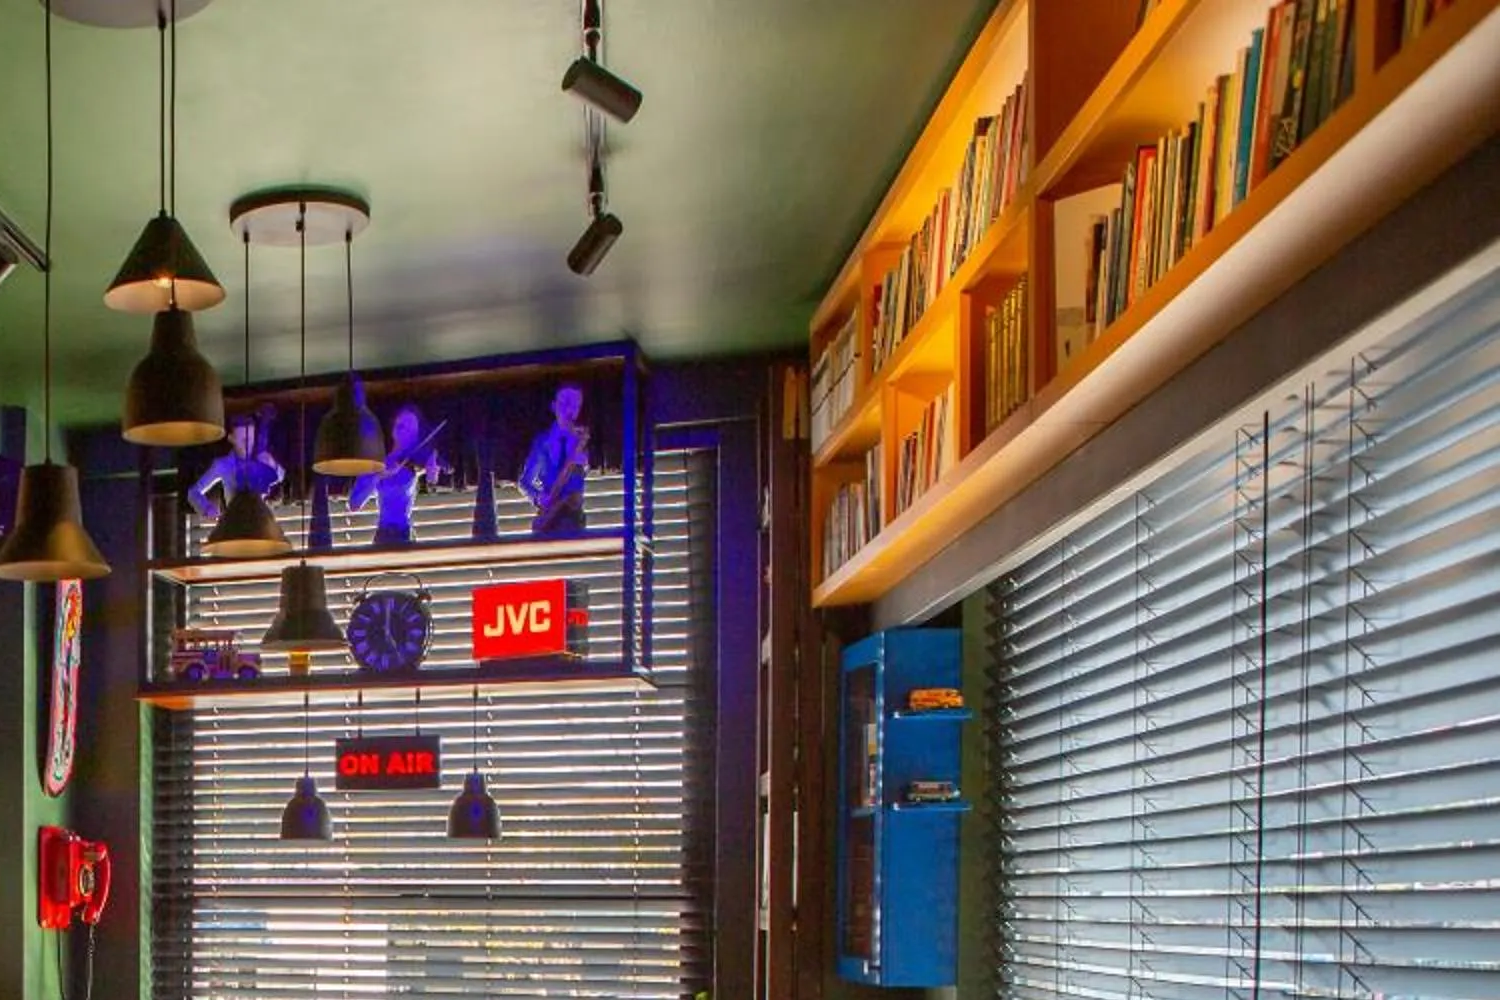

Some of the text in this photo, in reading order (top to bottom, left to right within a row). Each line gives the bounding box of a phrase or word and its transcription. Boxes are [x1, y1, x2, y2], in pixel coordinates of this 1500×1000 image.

[483, 600, 551, 637] JVC
[340, 750, 435, 777] ON AIR
